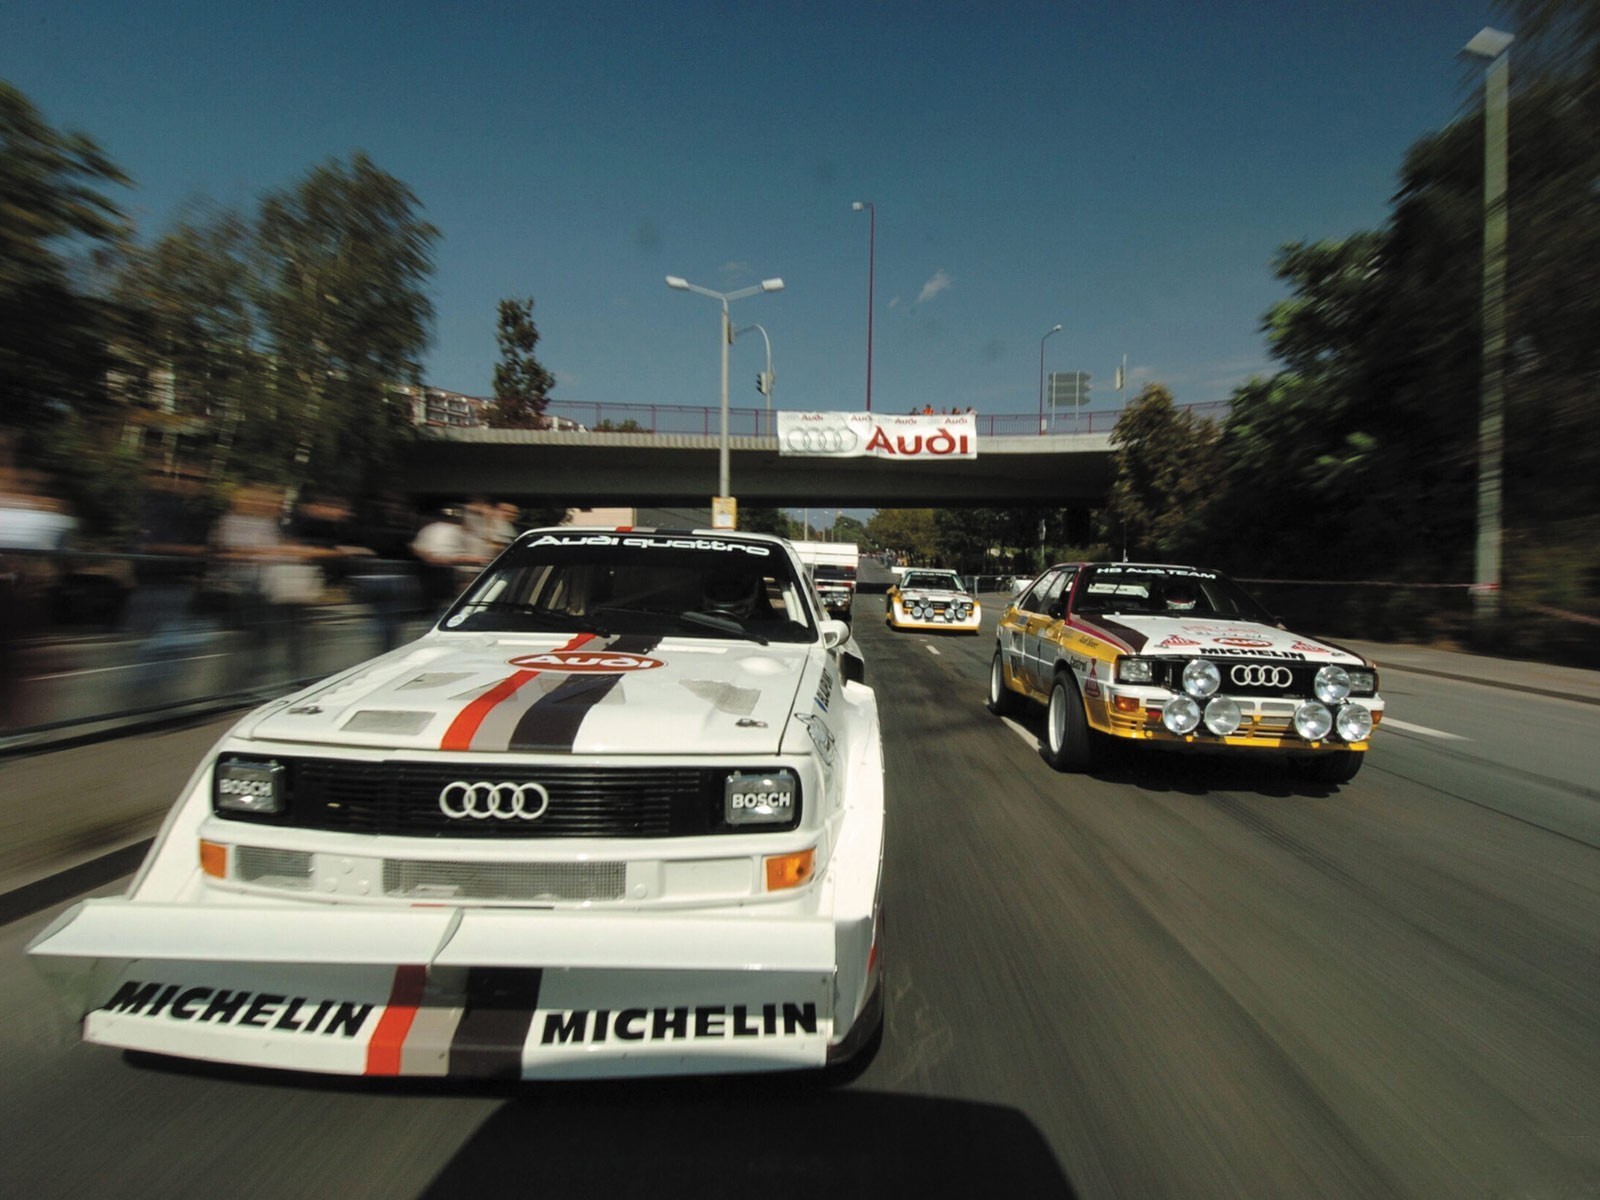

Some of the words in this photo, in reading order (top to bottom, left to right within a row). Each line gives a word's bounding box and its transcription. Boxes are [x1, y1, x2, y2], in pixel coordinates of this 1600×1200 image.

[945, 417, 968, 425] Audi
[865, 425, 968, 455] Audi
[527, 535, 619, 548] Audi
[623, 537, 770, 556] quattro
[1166, 569, 1217, 580] TEAM
[517, 654, 654, 668] Audi
[1199, 647, 1306, 661] MICHELIN
[219, 778, 273, 797] BOSCH
[731, 791, 791, 809] BOSCH
[102, 980, 376, 1038] MICHELIN
[540, 1002, 818, 1045] MICHELIN
